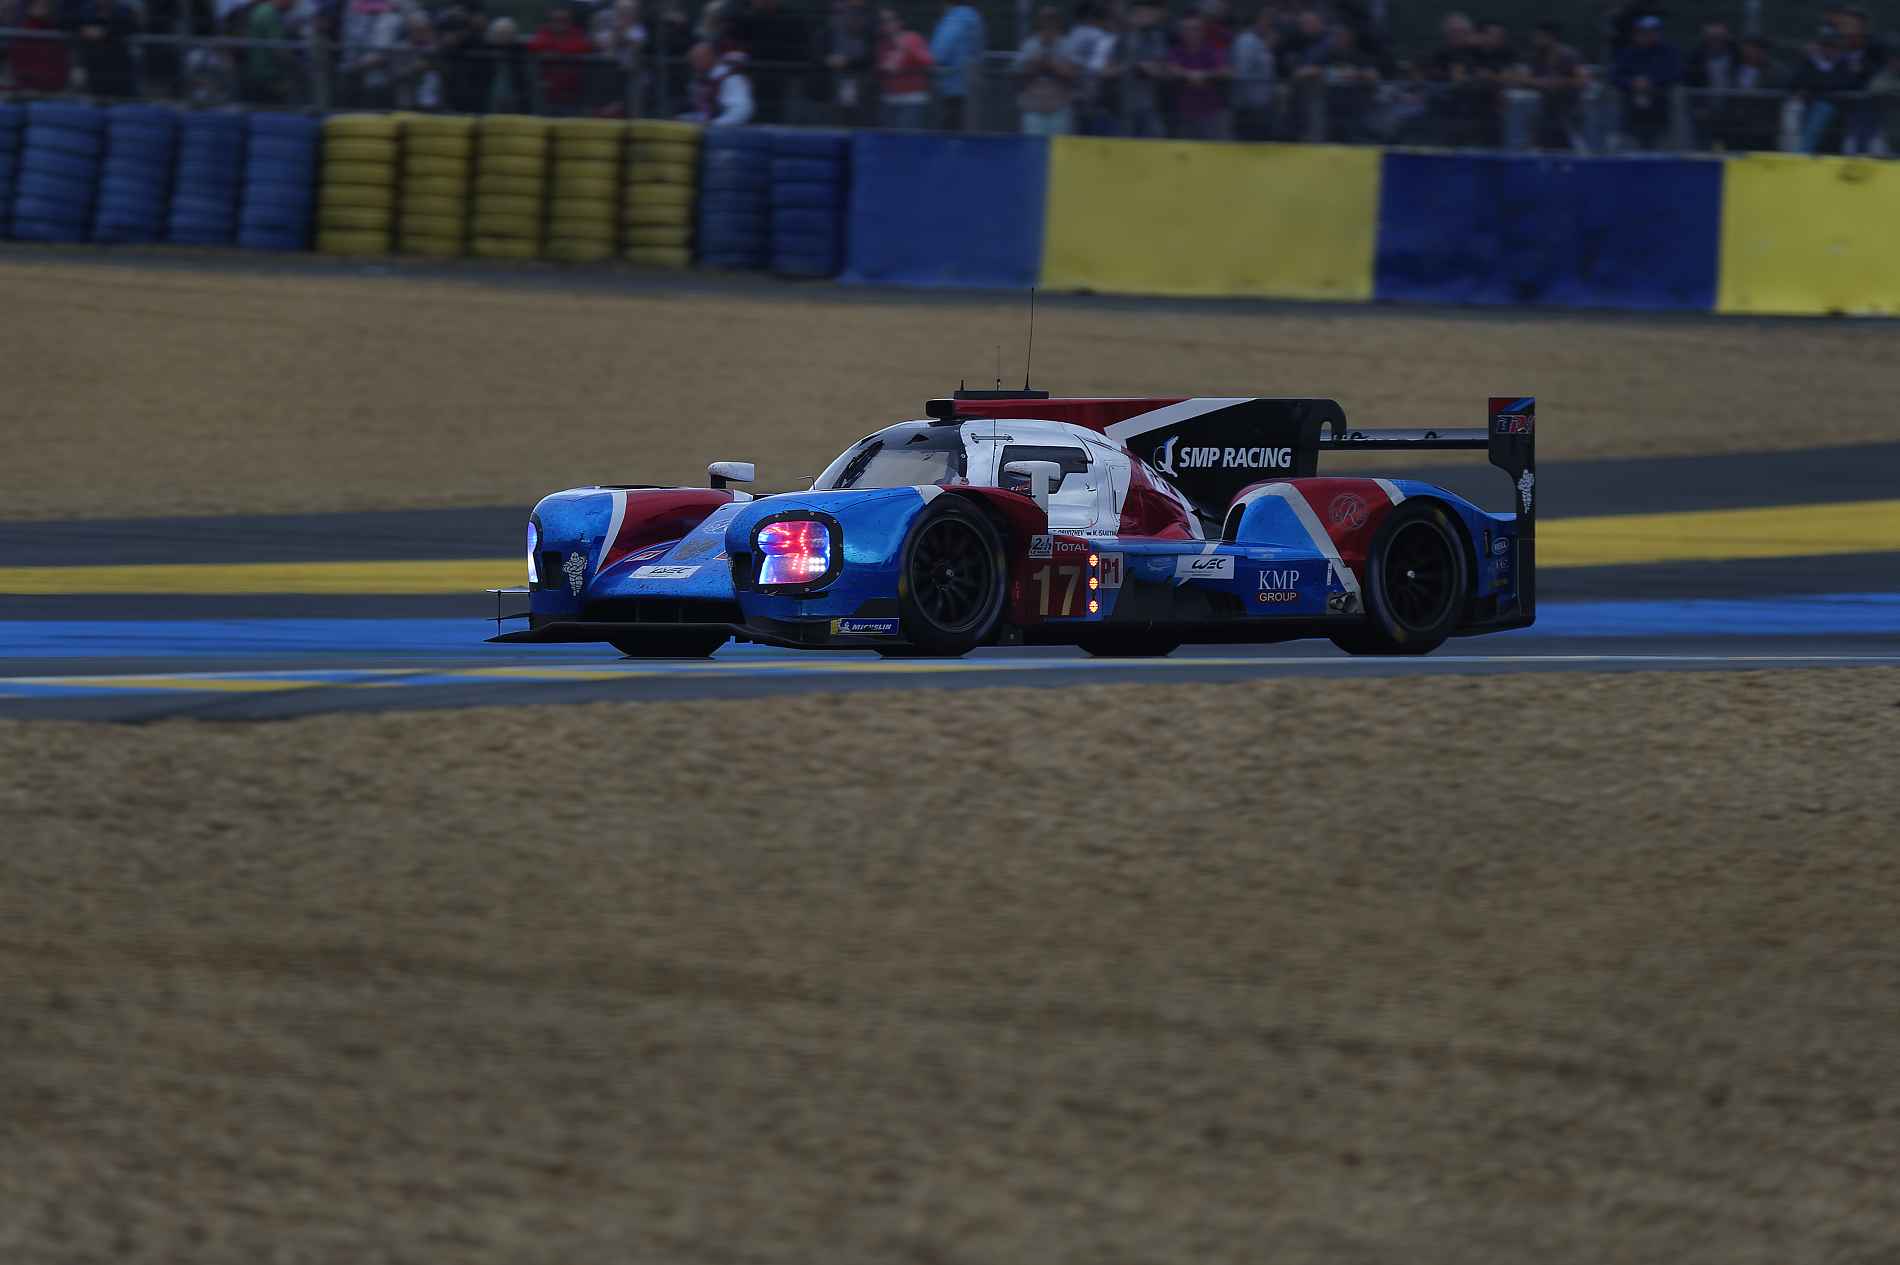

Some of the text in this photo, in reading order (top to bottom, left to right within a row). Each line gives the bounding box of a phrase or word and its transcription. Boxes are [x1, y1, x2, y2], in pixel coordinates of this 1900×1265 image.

[1179, 447, 1292, 468] SMP RACING
[1055, 541, 1088, 552] TOTAL
[1101, 558, 1120, 584] P1
[1192, 558, 1227, 570] WEC
[1032, 564, 1081, 616] 17
[1258, 570, 1300, 590] KMP
[1259, 592, 1297, 602] GROUP
